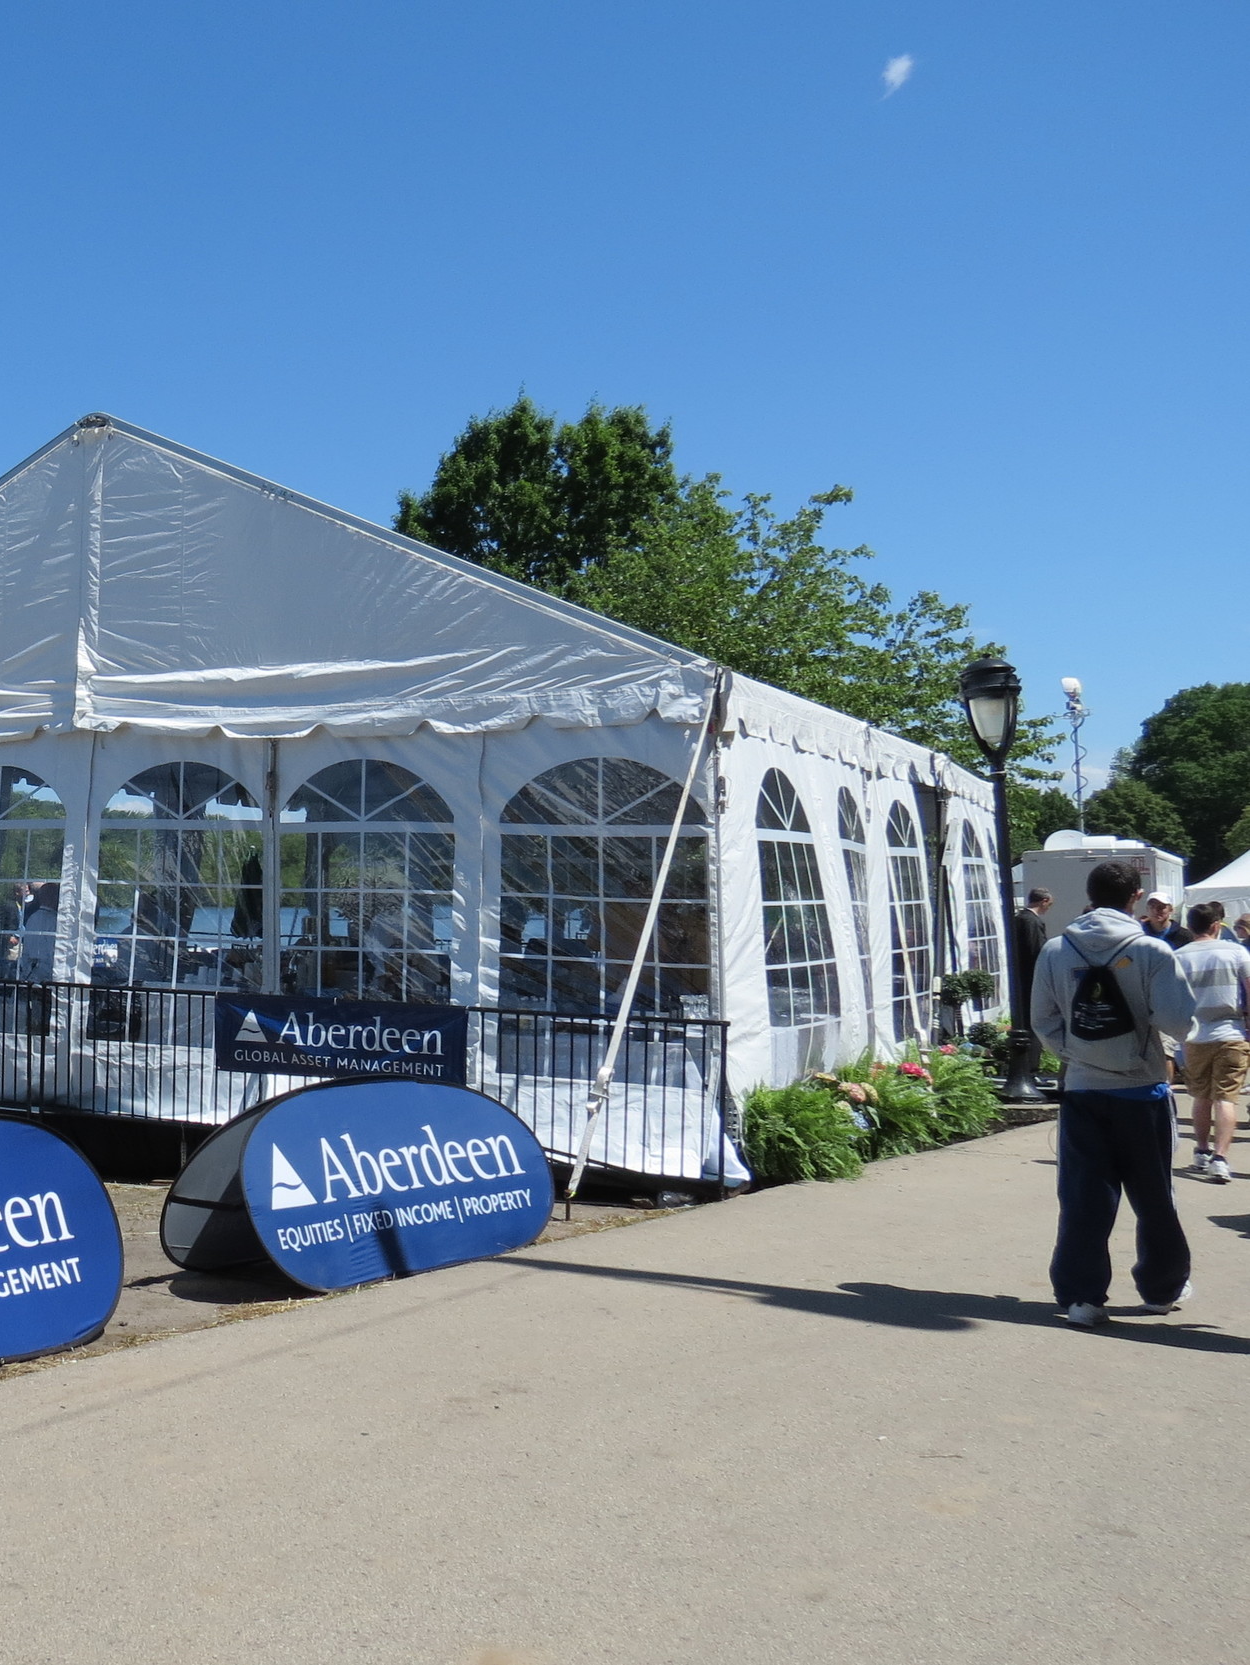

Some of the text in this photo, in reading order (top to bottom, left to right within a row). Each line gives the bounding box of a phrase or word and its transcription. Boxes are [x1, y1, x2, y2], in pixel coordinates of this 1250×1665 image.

[276, 1011, 445, 1056] Aberdeen
[234, 1049, 444, 1077] GLOBAL ASSET MANAGEMENT
[319, 1124, 526, 1204] Aberdeen
[277, 1188, 532, 1253] EQUITIES FIXED INCOME PROPERTY
